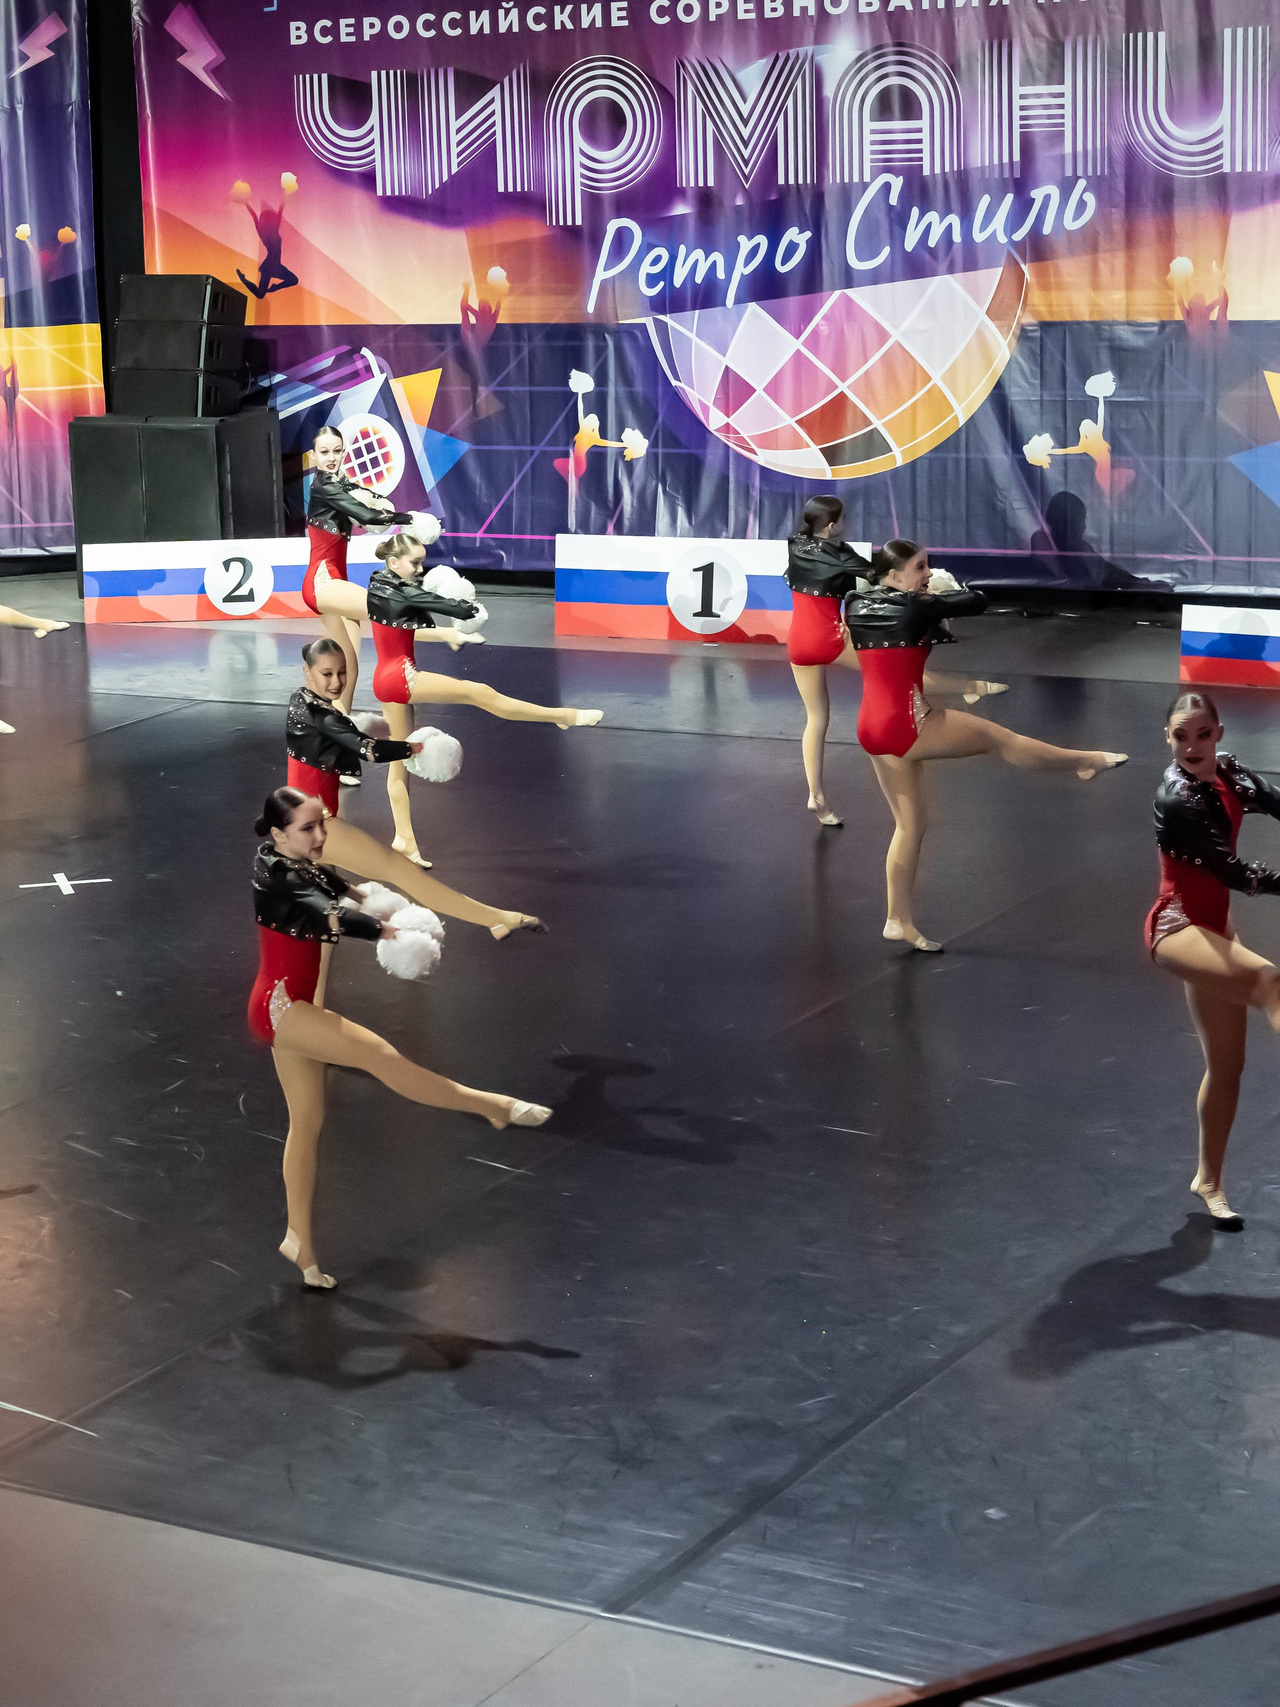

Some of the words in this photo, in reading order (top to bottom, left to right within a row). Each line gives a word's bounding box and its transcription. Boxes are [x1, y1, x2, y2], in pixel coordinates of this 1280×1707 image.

[289, 1, 629, 45] ВСЕРОССИЙСКИЕ
[649, 0, 1010, 25] СОРЕВНОВ
[293, 26, 1273, 226] ЧИРМАНИ
[587, 217, 812, 314] Ретро
[846, 173, 1096, 270] Стиль
[222, 556, 255, 603] 2
[692, 561, 721, 618] 1
